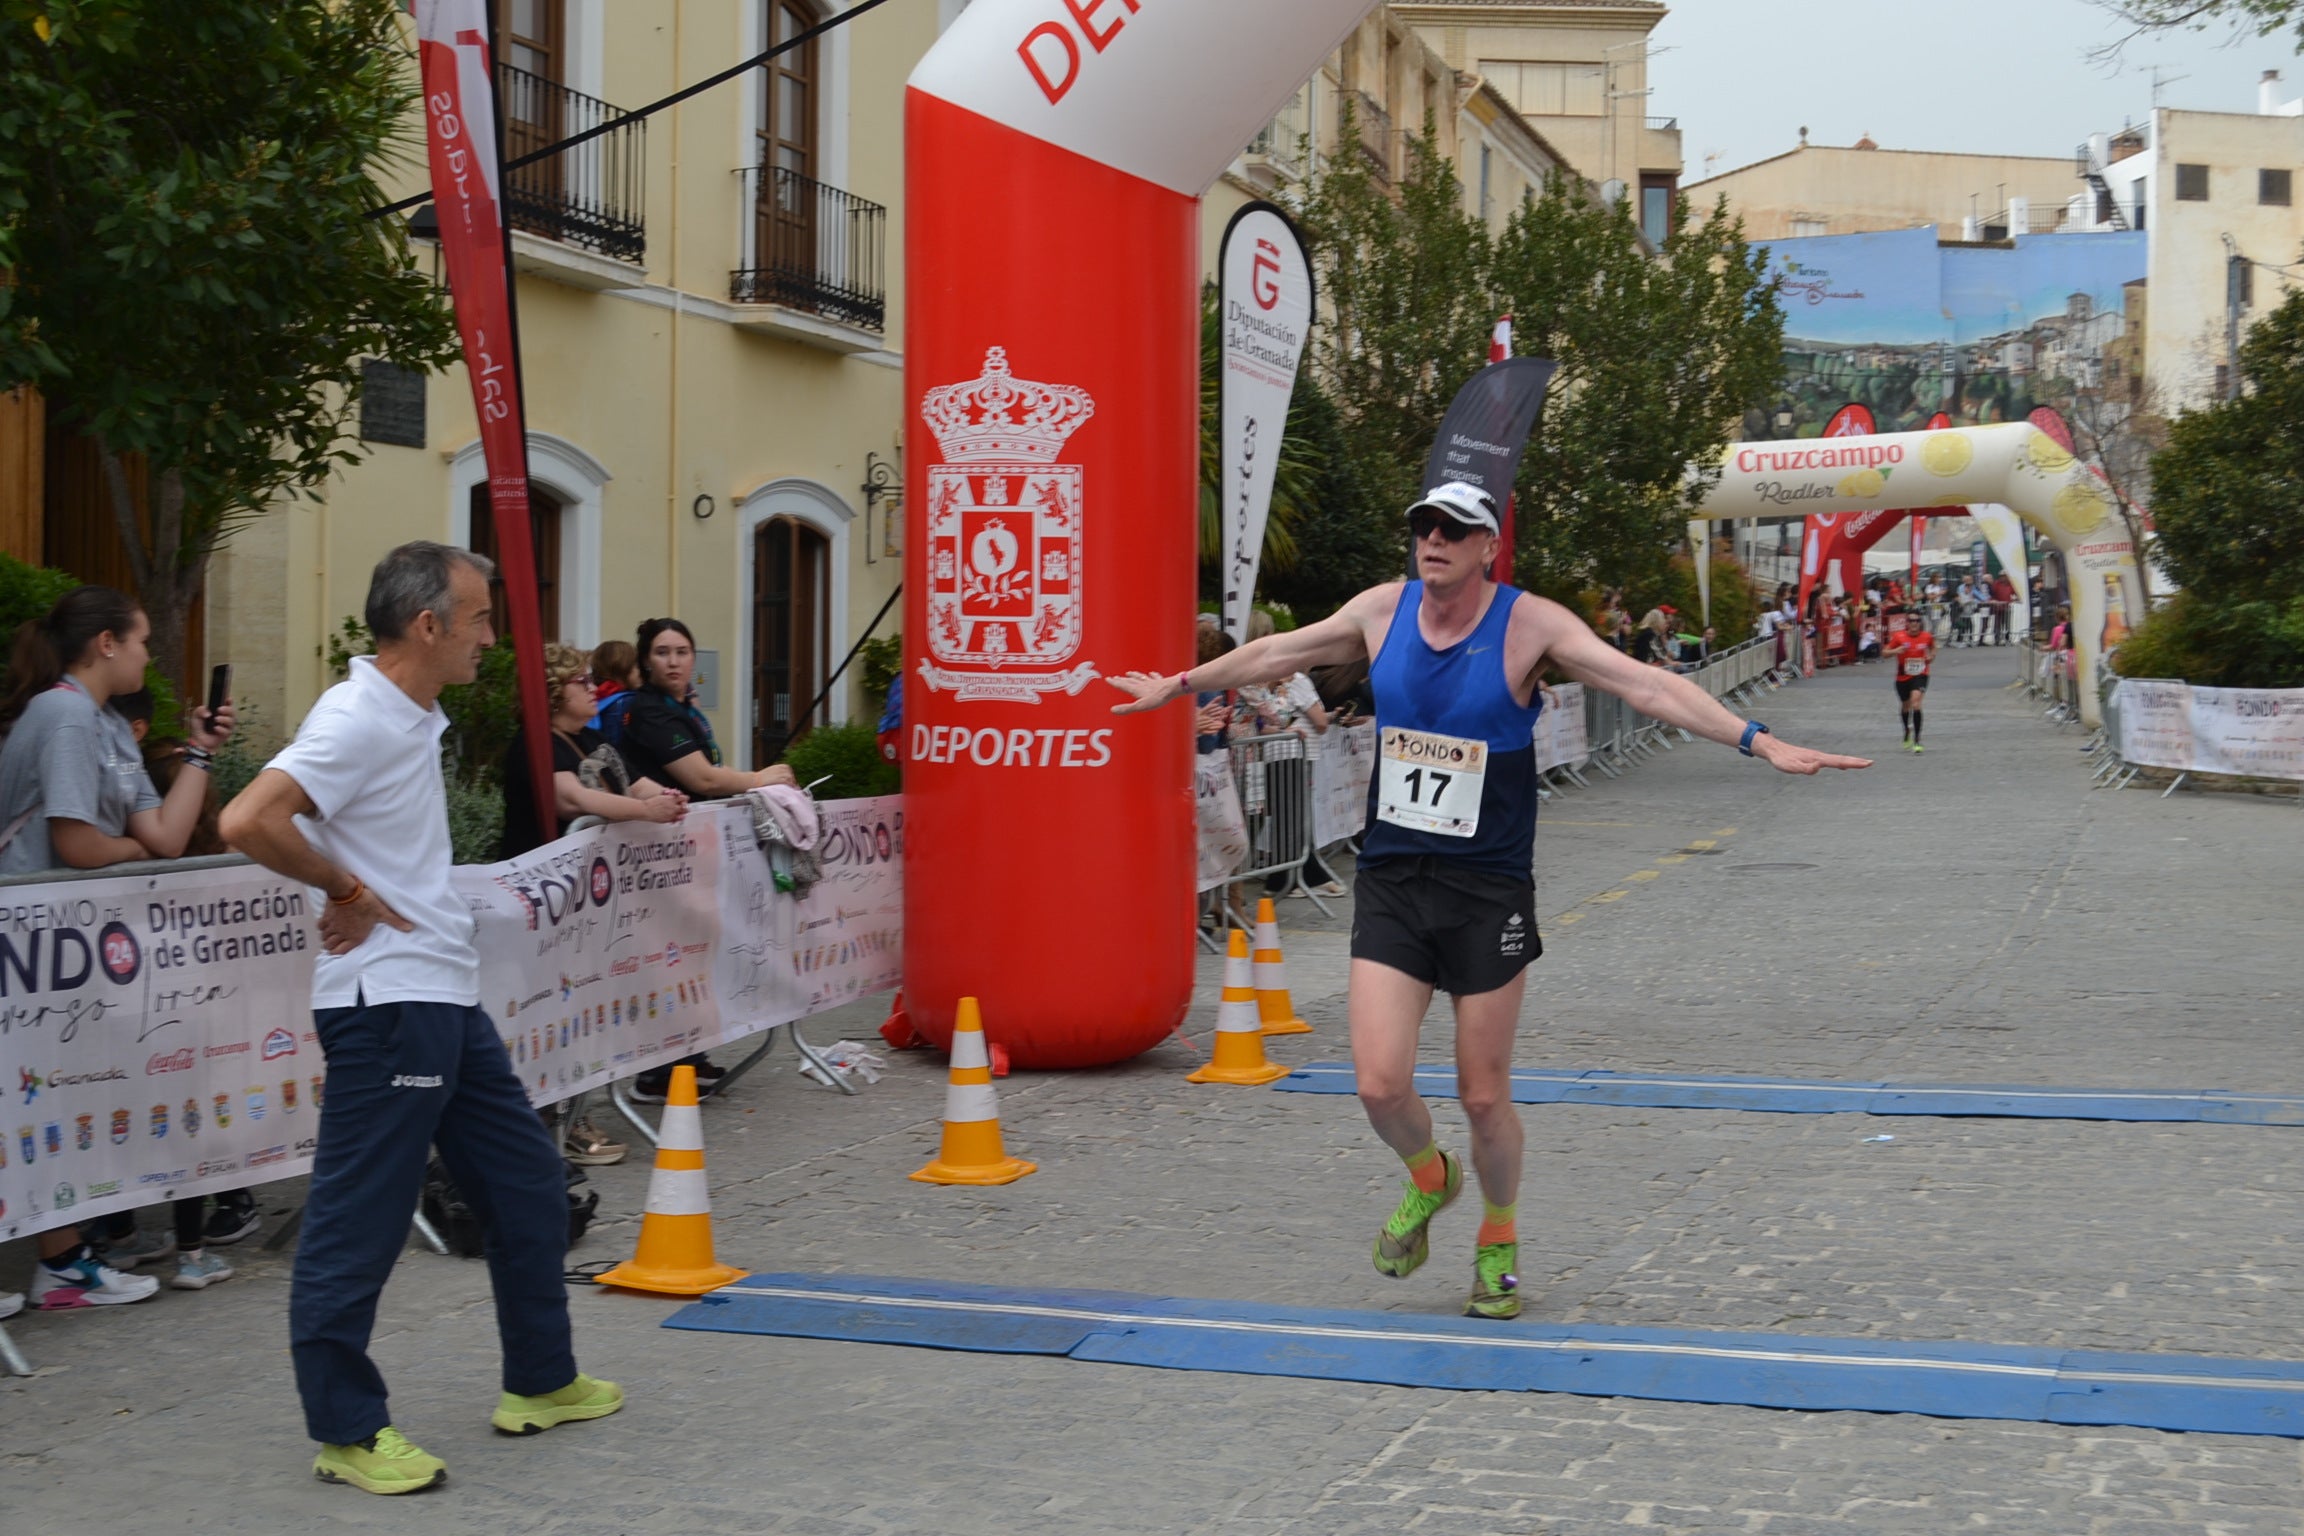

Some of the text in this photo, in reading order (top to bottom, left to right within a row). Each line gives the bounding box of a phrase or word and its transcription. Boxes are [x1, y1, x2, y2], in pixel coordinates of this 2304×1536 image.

[1016, 0, 1141, 106] DE
[1228, 300, 1296, 347] Diputación
[1227, 327, 1296, 371] de Granada
[1447, 450, 1471, 464] that
[1450, 433, 1510, 457] Movement
[1737, 443, 1904, 473] Cruzcampo
[1441, 466, 1485, 485] inspires
[1754, 480, 1836, 505] Radler
[912, 724, 1114, 767] DEPORTES
[1404, 768, 1452, 807] 17
[616, 834, 697, 872] Diputación
[820, 823, 891, 866] ONDO
[619, 862, 694, 895] de Granada
[147, 887, 304, 939] Diputación
[106, 940, 133, 965] 24
[155, 923, 306, 969] de Granada
[48, 1068, 130, 1088] Granada
[146, 1047, 195, 1075] Coca-Cola
